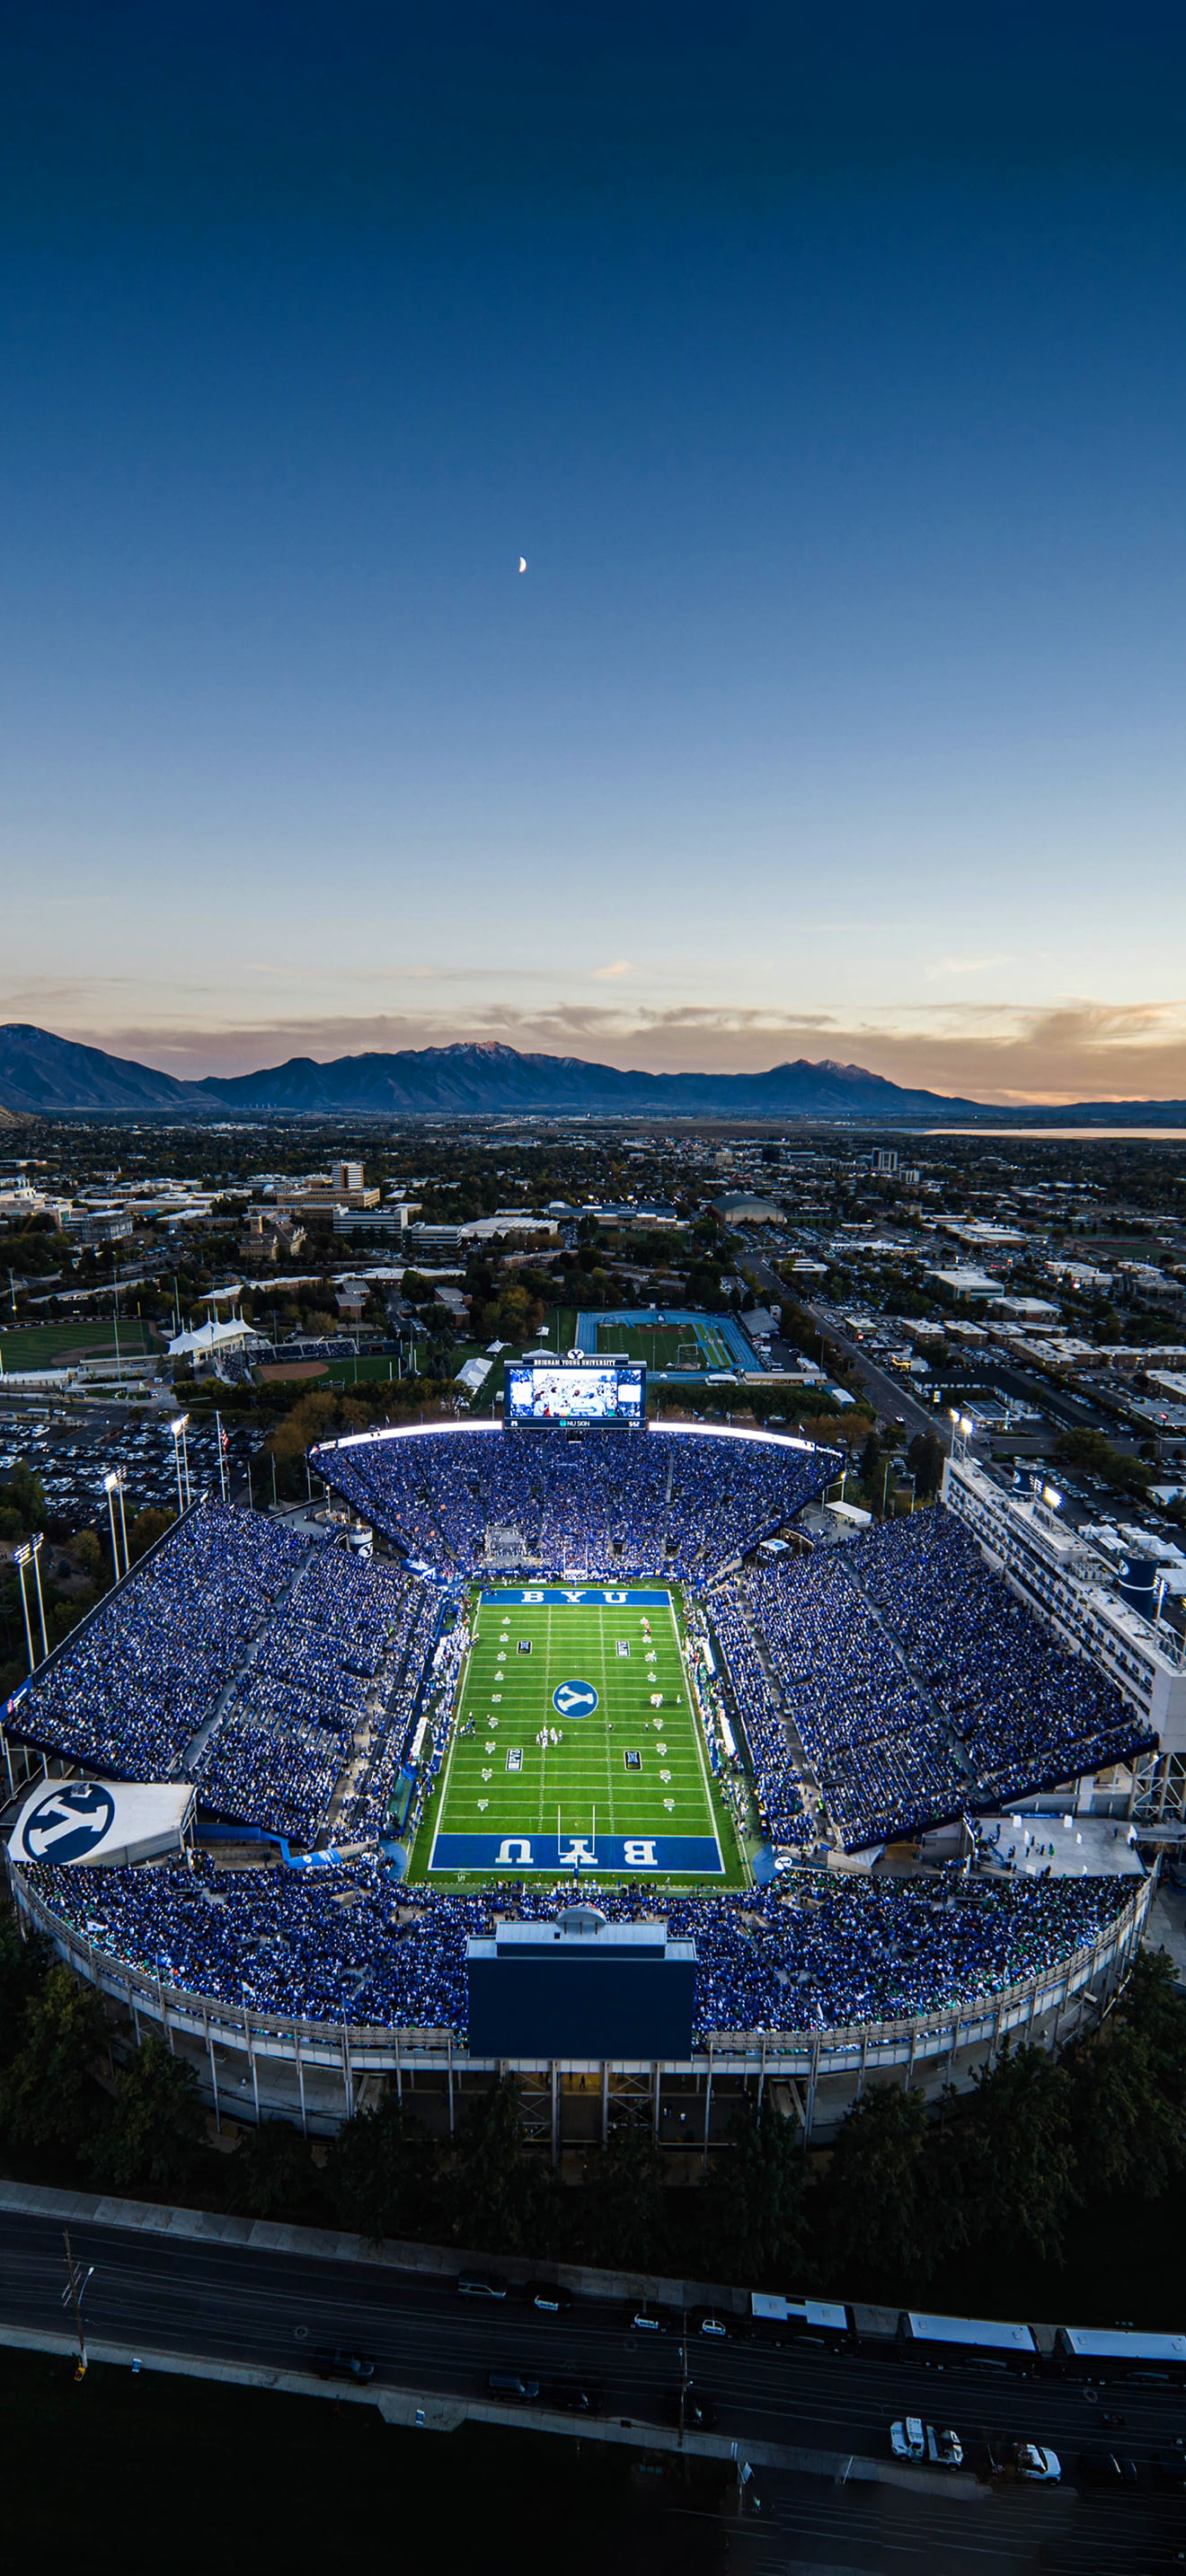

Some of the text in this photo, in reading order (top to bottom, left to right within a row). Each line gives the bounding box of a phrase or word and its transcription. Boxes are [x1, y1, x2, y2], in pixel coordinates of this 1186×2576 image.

[521, 1591, 628, 1603] BYU
[557, 1685, 594, 1712] Y
[481, 1768, 493, 1778] 20
[659, 1769, 671, 1780] 20
[29, 1795, 109, 1856] Y
[495, 1839, 659, 1866] BYU
